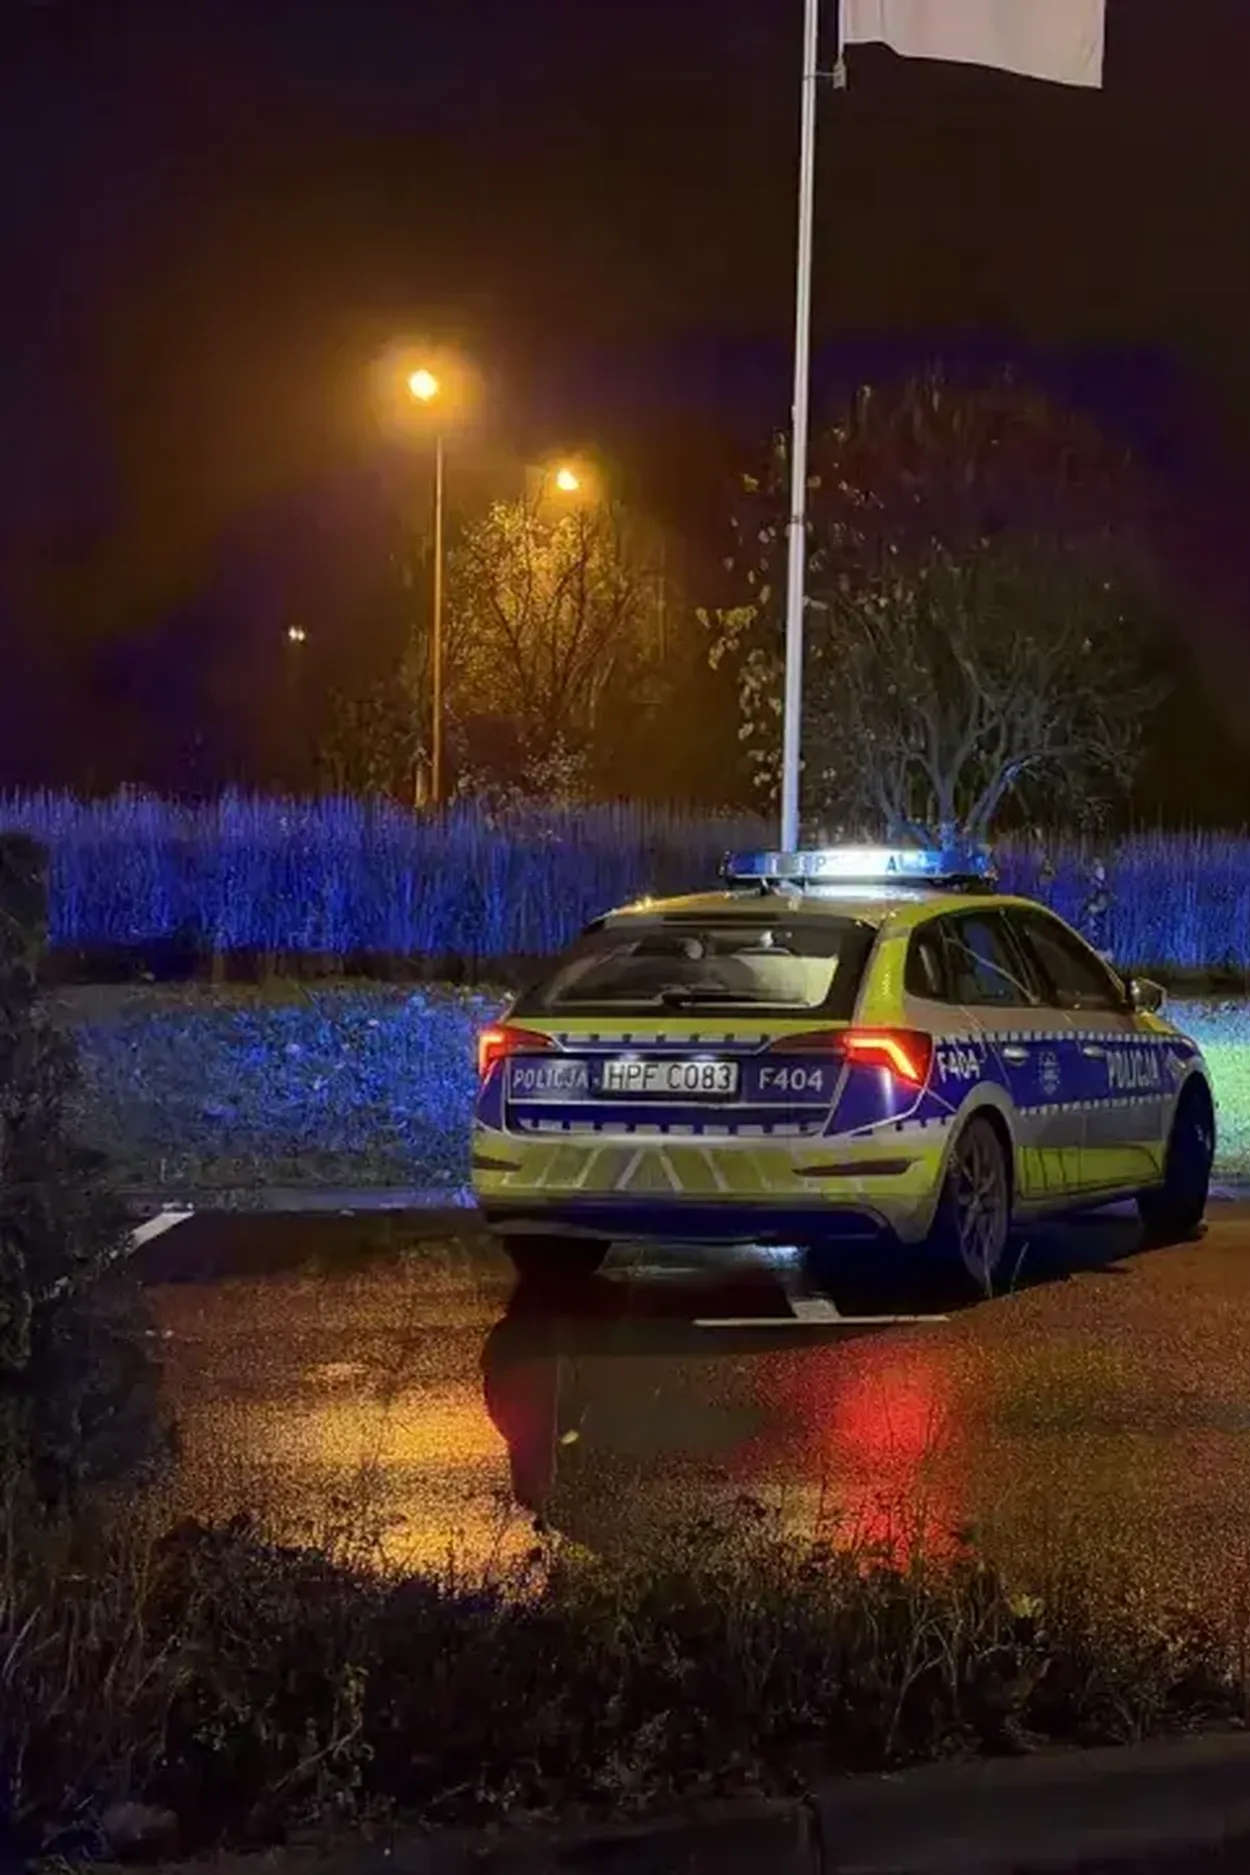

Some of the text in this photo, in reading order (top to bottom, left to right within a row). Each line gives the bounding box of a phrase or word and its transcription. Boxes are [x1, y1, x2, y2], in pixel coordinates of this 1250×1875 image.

[512, 1067, 589, 1090] POLICJA
[608, 1063, 732, 1090] HPF C083
[937, 1049, 981, 1084] F404
[758, 1067, 824, 1093] F404
